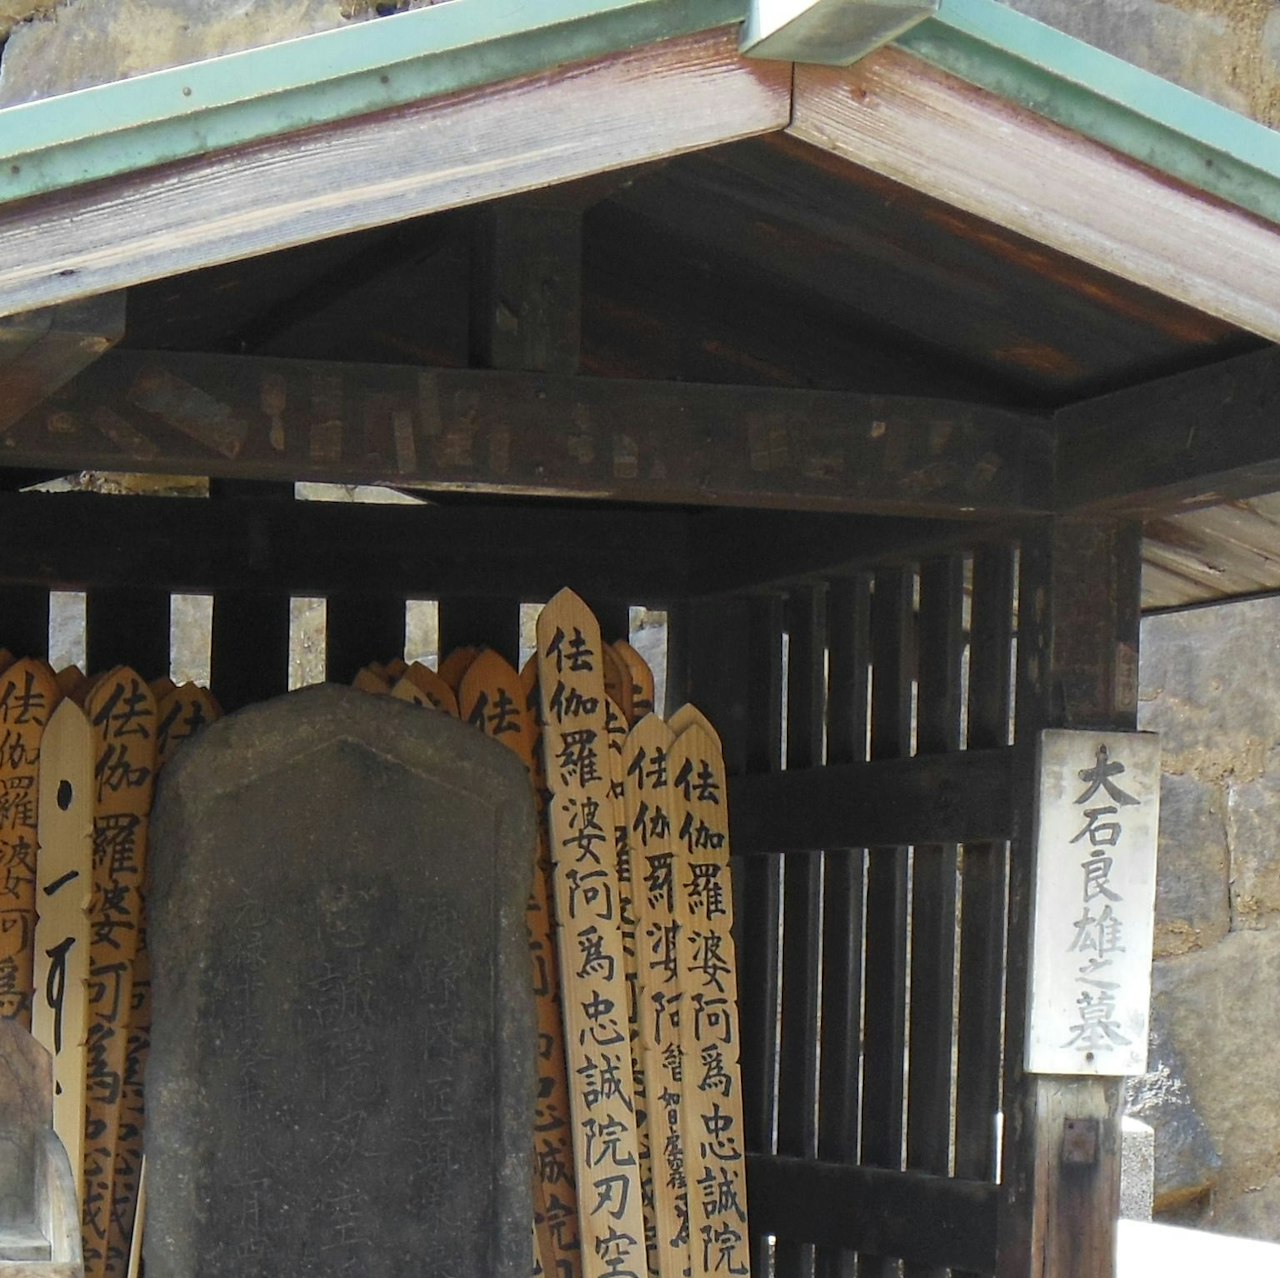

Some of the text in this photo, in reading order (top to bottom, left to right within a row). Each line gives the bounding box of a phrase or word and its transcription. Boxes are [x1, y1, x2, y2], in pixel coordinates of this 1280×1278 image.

[1059, 747, 1141, 1053] 大石良雄之墓
